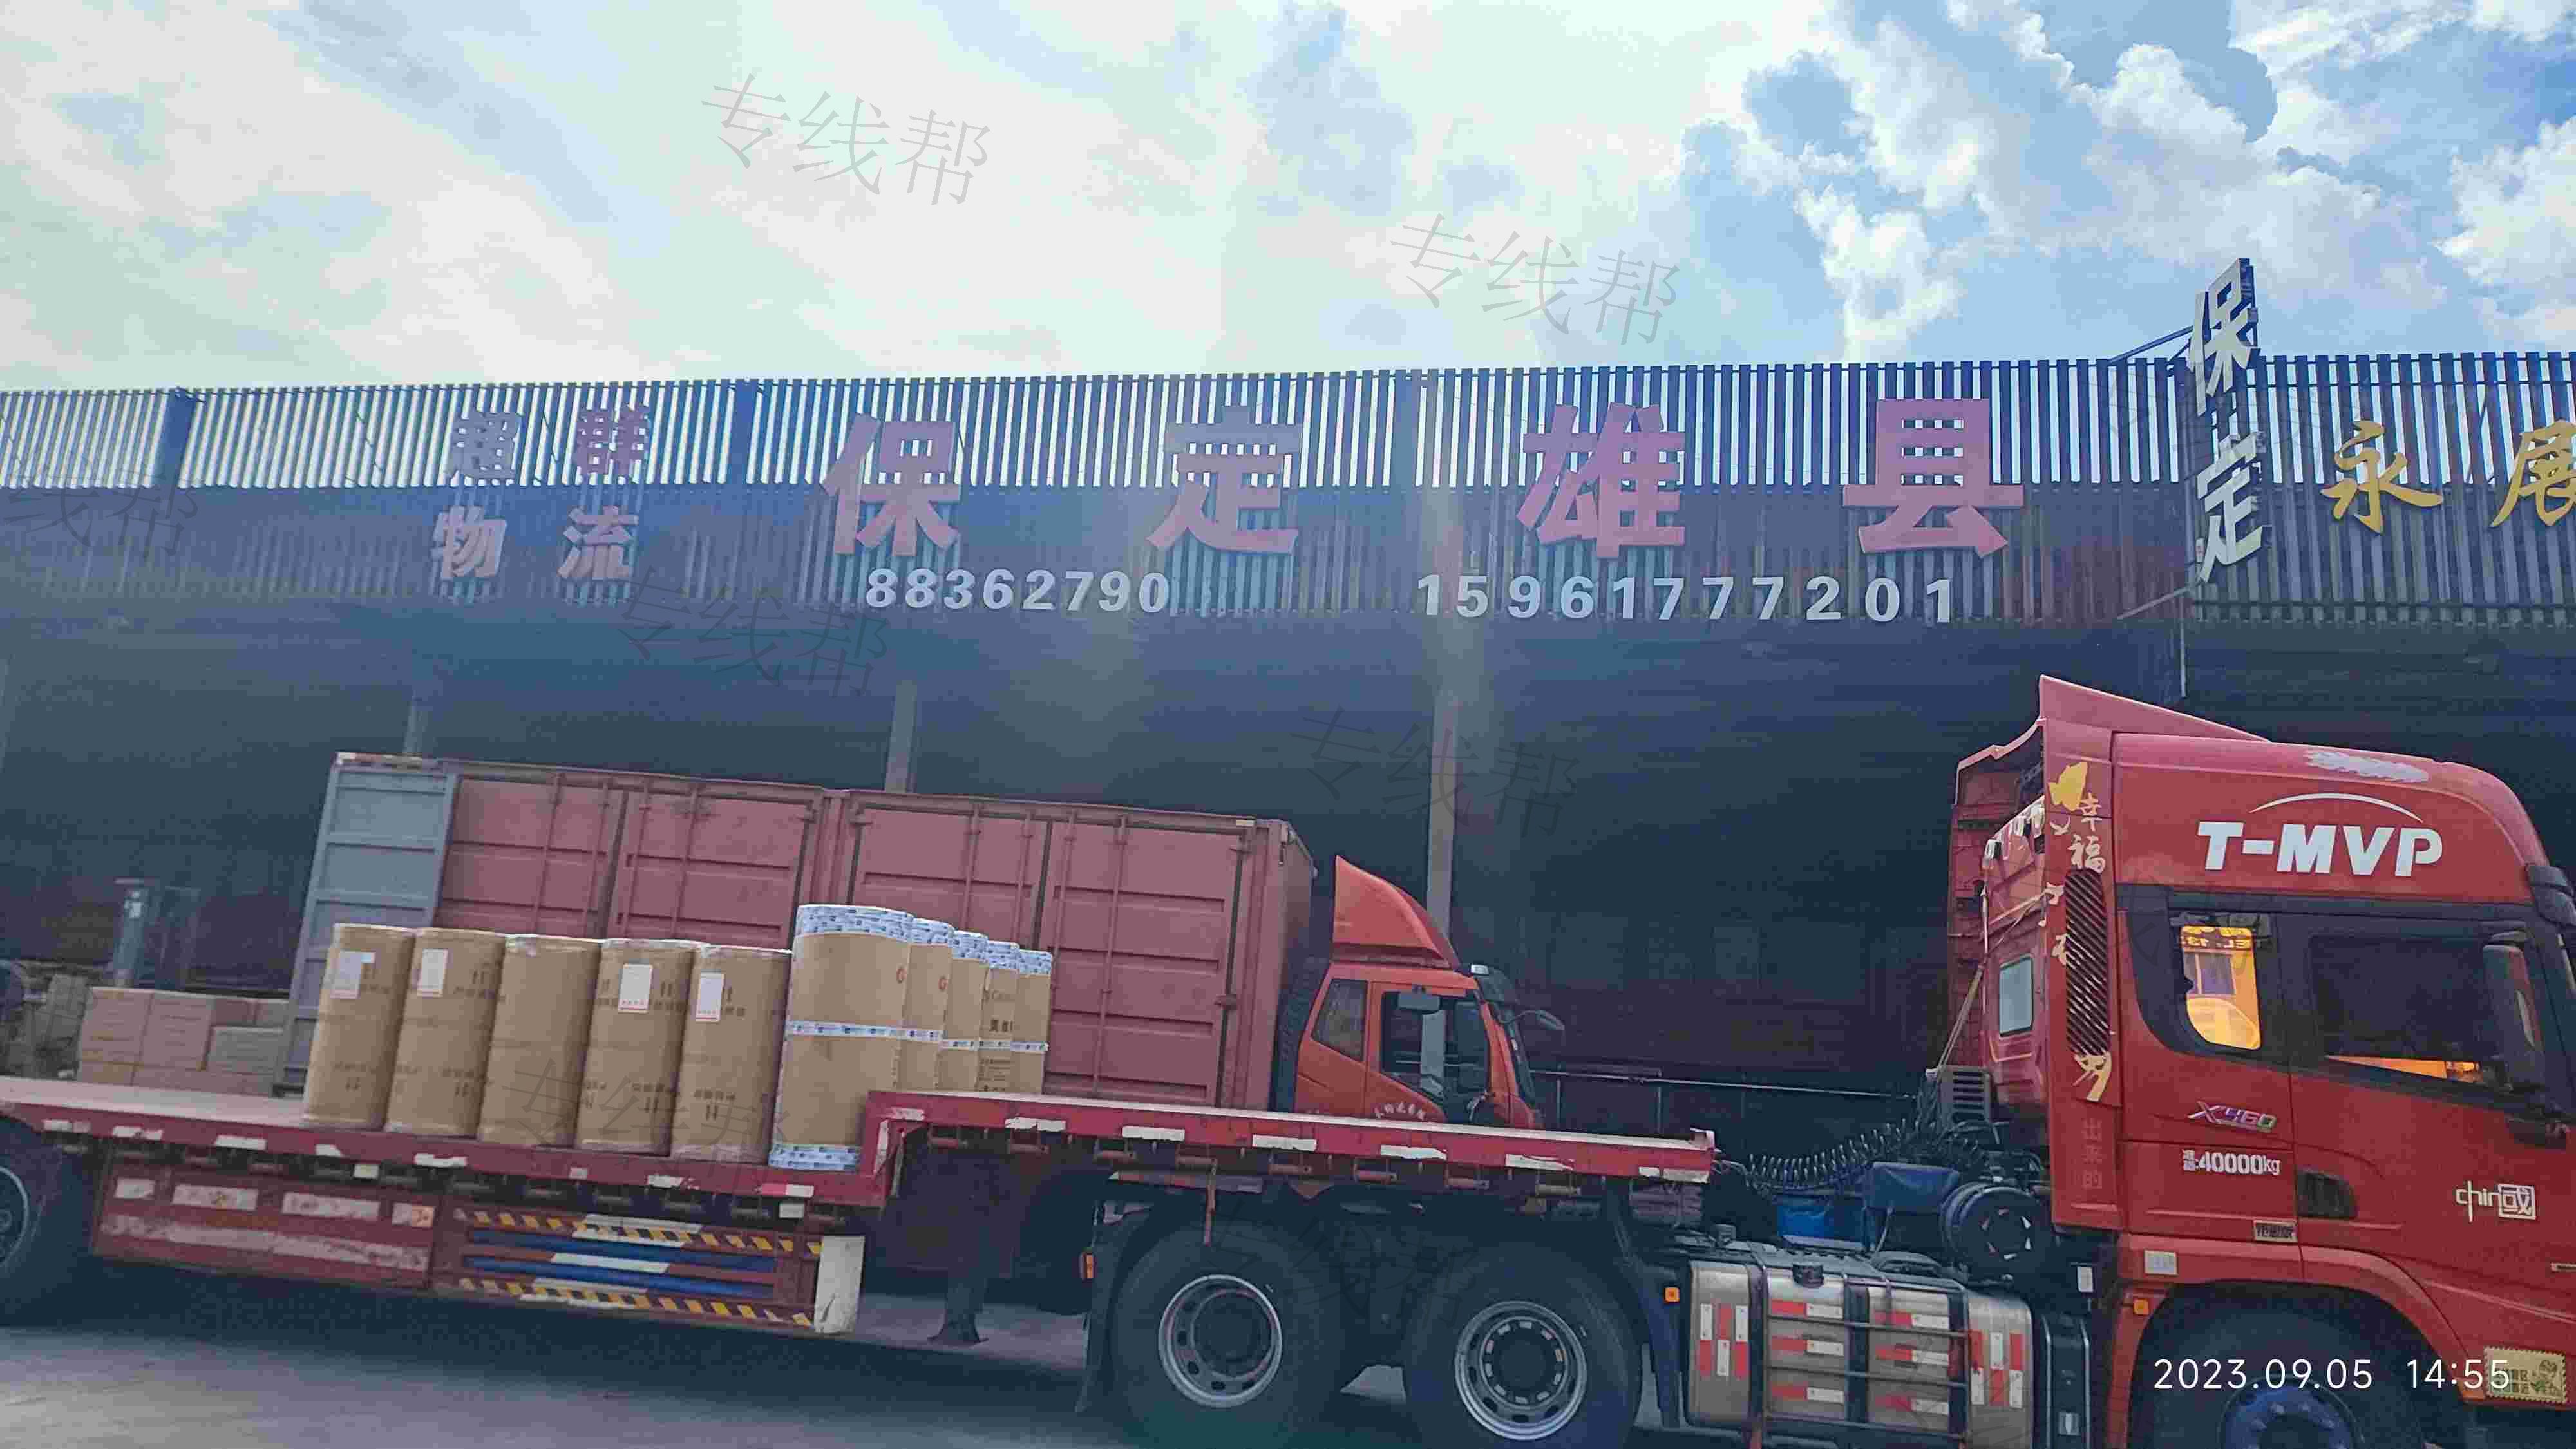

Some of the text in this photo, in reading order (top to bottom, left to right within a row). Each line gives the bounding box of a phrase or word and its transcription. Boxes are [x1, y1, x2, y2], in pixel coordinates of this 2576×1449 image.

[2186, 258, 2262, 583] 保定
[819, 397, 2024, 558] 保定雄县
[430, 505, 639, 580] 物流
[866, 567, 1170, 613] 88362790
[1417, 574, 1954, 624] 15961777201
[2067, 792, 2106, 873] 幸福
[2197, 820, 2443, 877] T-MVP
